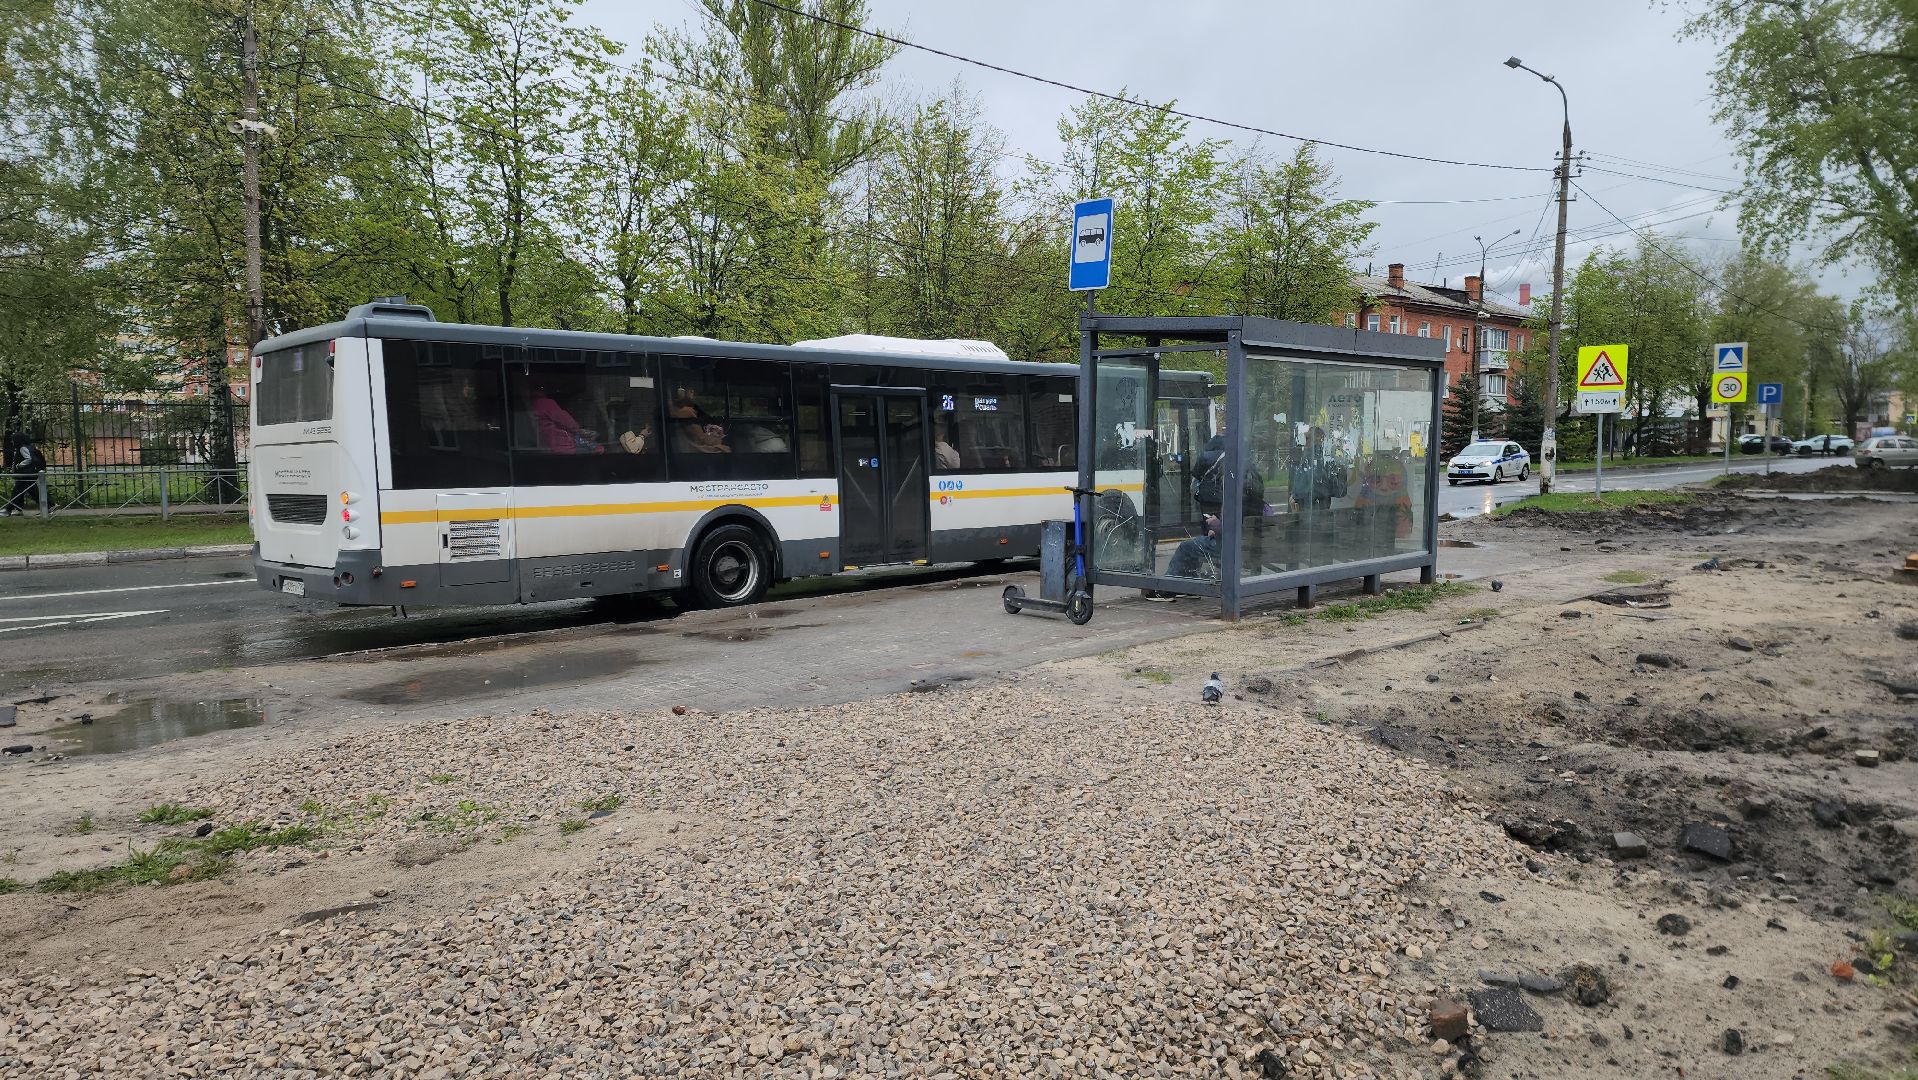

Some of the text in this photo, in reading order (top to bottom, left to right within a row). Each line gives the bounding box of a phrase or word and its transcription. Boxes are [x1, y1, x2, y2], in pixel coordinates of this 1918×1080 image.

[1723, 383, 1737, 392] 30
[1763, 386, 1777, 402] P
[942, 394, 954, 411] 26
